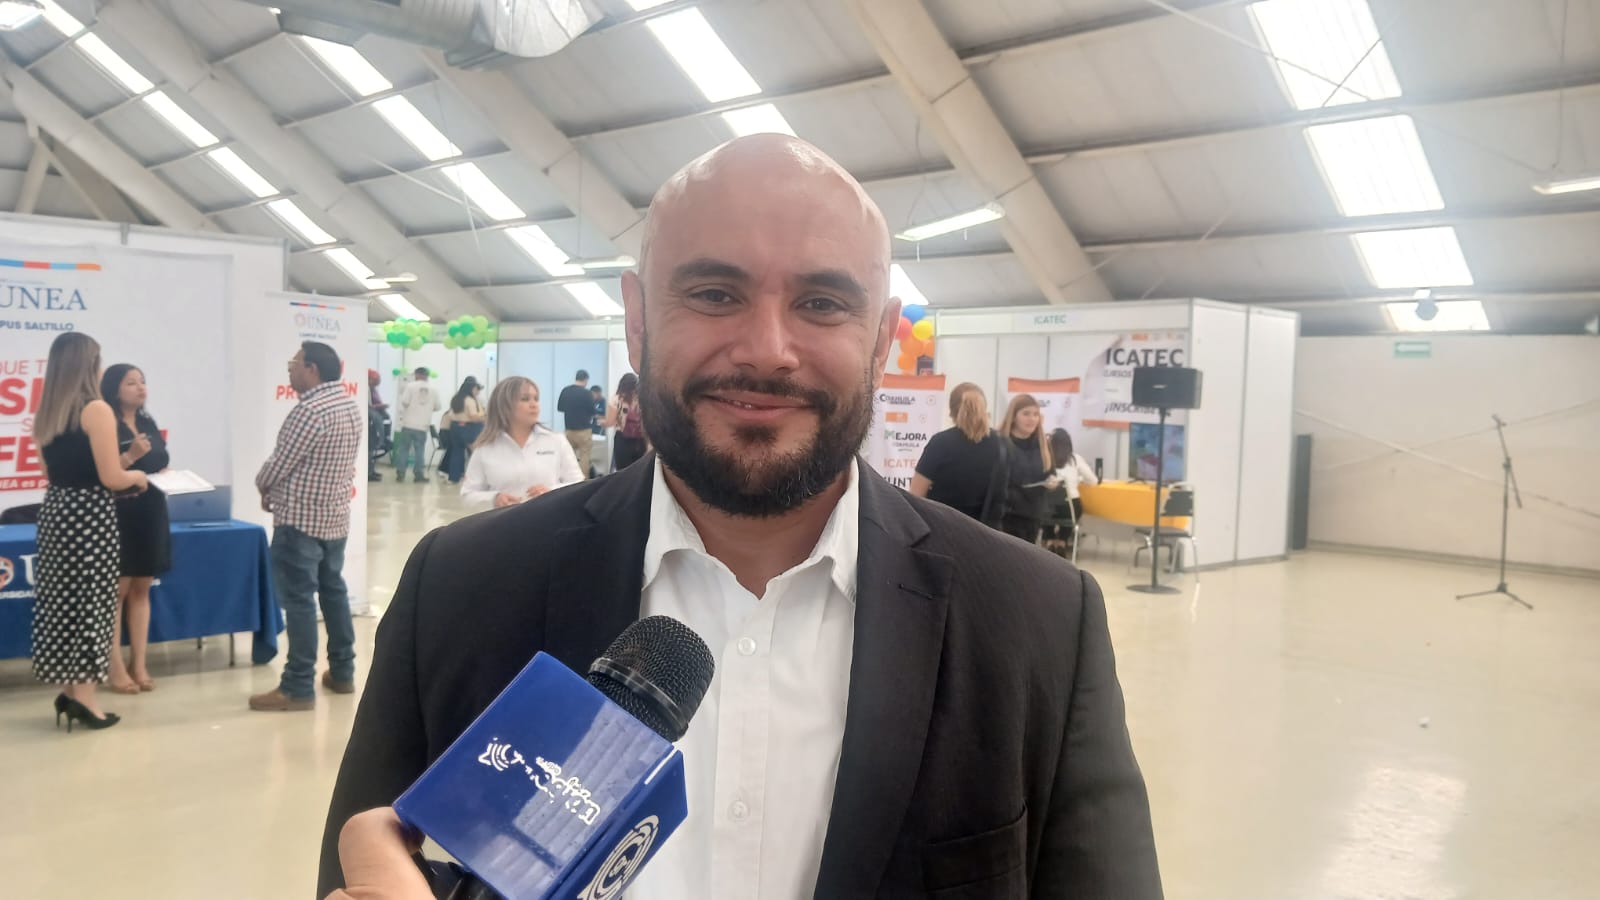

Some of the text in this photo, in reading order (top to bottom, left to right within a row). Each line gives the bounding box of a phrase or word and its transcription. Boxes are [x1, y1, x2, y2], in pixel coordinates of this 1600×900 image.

[1033, 313, 1067, 325] ICATEC
[24, 321, 75, 331] SALTILLO
[1105, 347, 1184, 368] ICATEC
[0, 359, 29, 375] UE
[884, 429, 927, 441] MEJORA
[883, 457, 917, 469] ICATE
